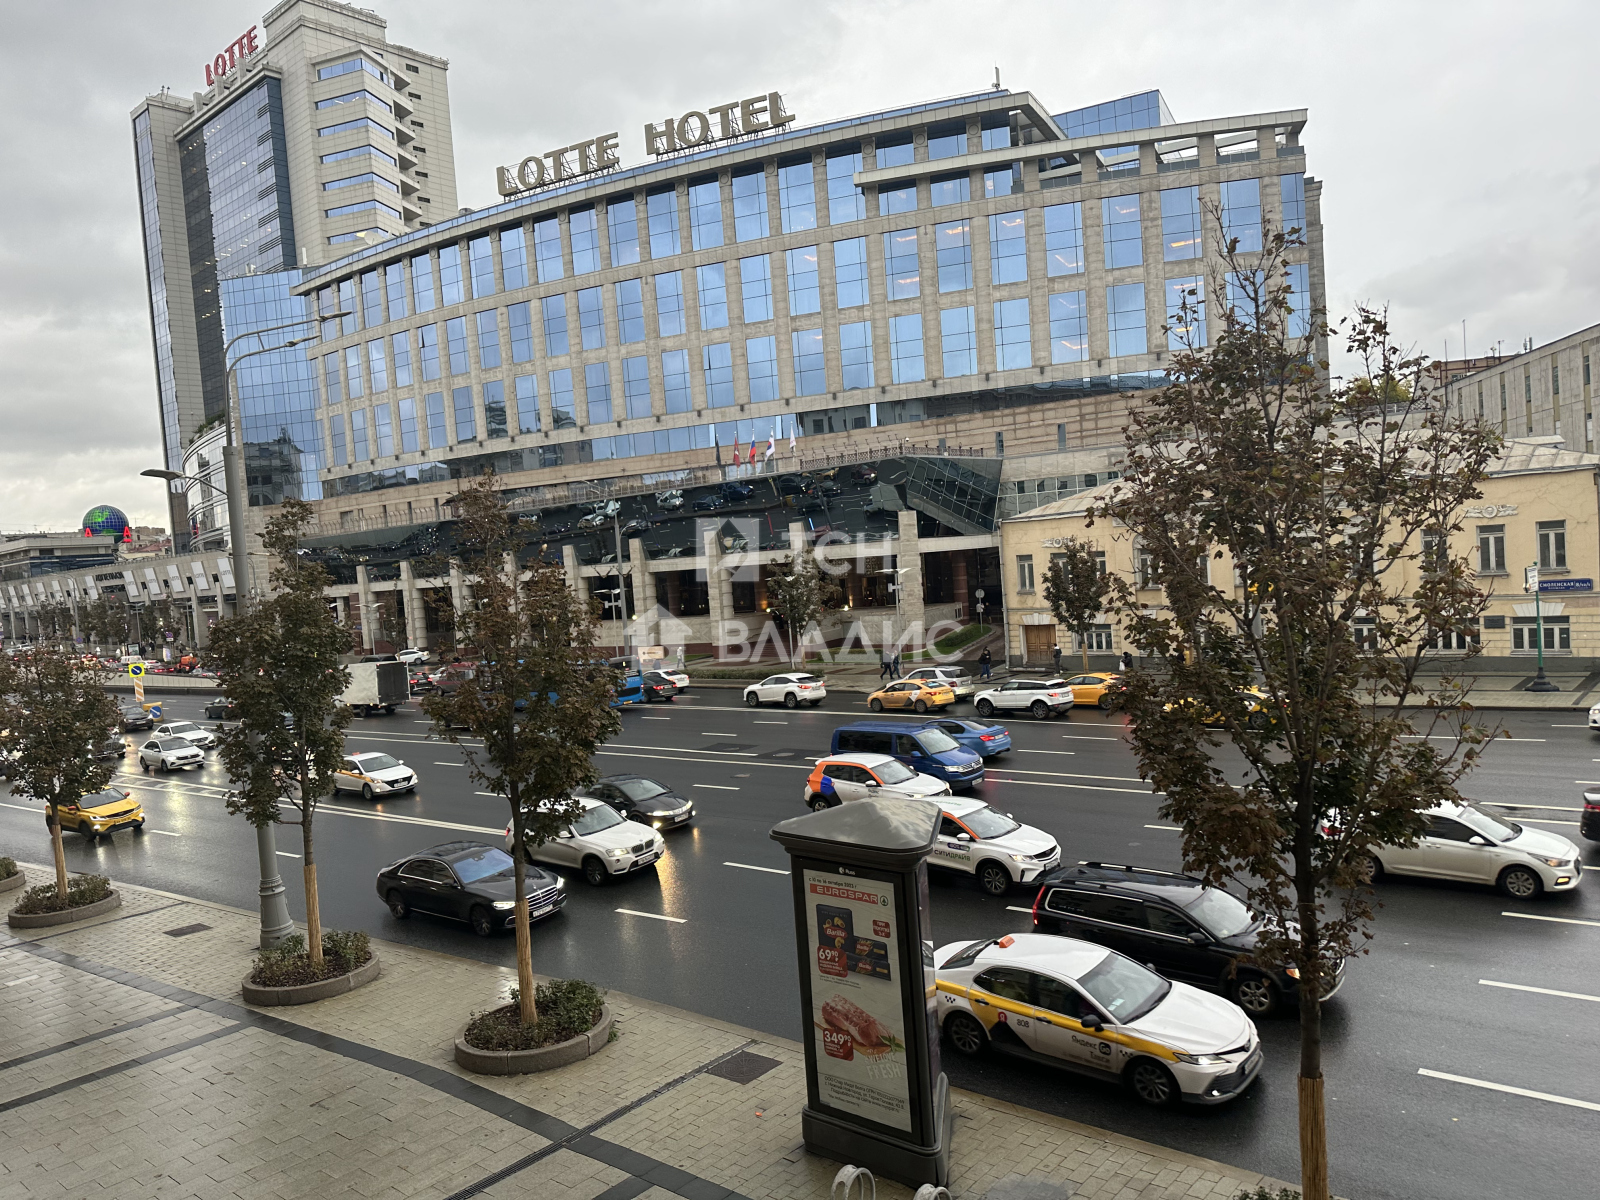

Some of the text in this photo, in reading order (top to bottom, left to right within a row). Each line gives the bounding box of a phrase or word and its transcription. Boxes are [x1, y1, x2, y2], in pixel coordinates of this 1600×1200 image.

[205, 25, 259, 87] LOTTE
[496, 91, 796, 196] LOTTE HOTEL
[934, 849, 971, 861] СИТИДРАЙВ
[816, 886, 878, 903] EUROSPAR
[826, 928, 846, 937] Barilla
[819, 948, 832, 960] 69
[824, 1030, 845, 1045] 349
[1071, 1035, 1110, 1053] Яндекс Go
[866, 1063, 902, 1080] FRESH
